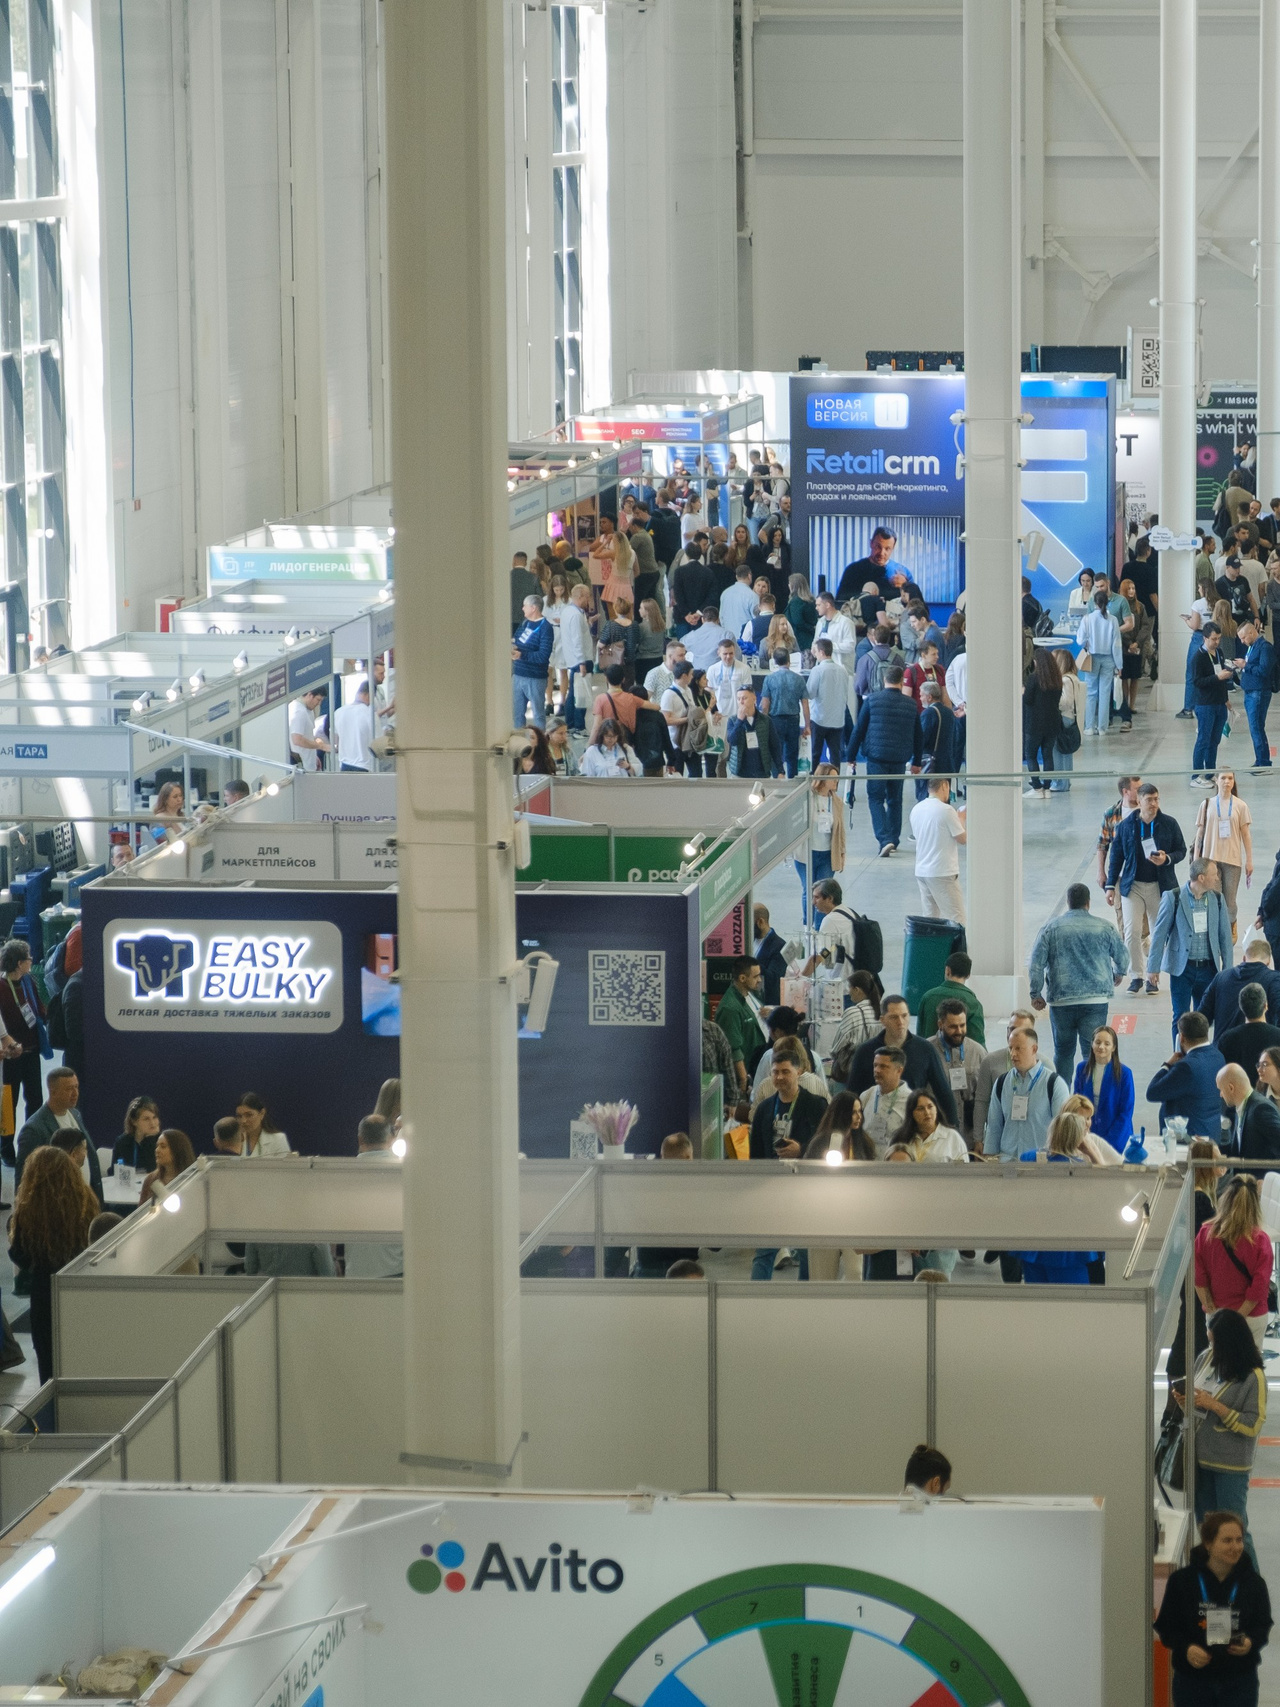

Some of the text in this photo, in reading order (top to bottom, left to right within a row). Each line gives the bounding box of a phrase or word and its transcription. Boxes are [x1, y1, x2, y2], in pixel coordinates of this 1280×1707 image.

[814, 399, 862, 410] НОВАЯ
[814, 411, 868, 422] ВЕРСИЯ
[1206, 418, 1244, 434] what
[806, 481, 949, 493] Платформа для CRM-маркетинга,
[806, 493, 839, 502] продаж
[848, 493, 897, 502] лояльности
[17, 746, 46, 757] ТАРА
[257, 847, 280, 856] ДЛЯ
[365, 847, 387, 857] ДЛЯ
[222, 857, 317, 868] МАРКЕТПЛЕЙСОВ
[374, 860, 381, 868] И
[732, 905, 742, 955] MOZZAR
[209, 941, 306, 969] EASY
[713, 973, 734, 981] GELL
[202, 971, 328, 1000] BULKY
[118, 1007, 332, 1020] легкая доставка тяжелых заказов
[470, 1542, 625, 1595] Avito
[749, 1602, 759, 1614] 7
[857, 1605, 864, 1618] 1
[654, 1653, 665, 1667] 5
[950, 1660, 960, 1673] 9
